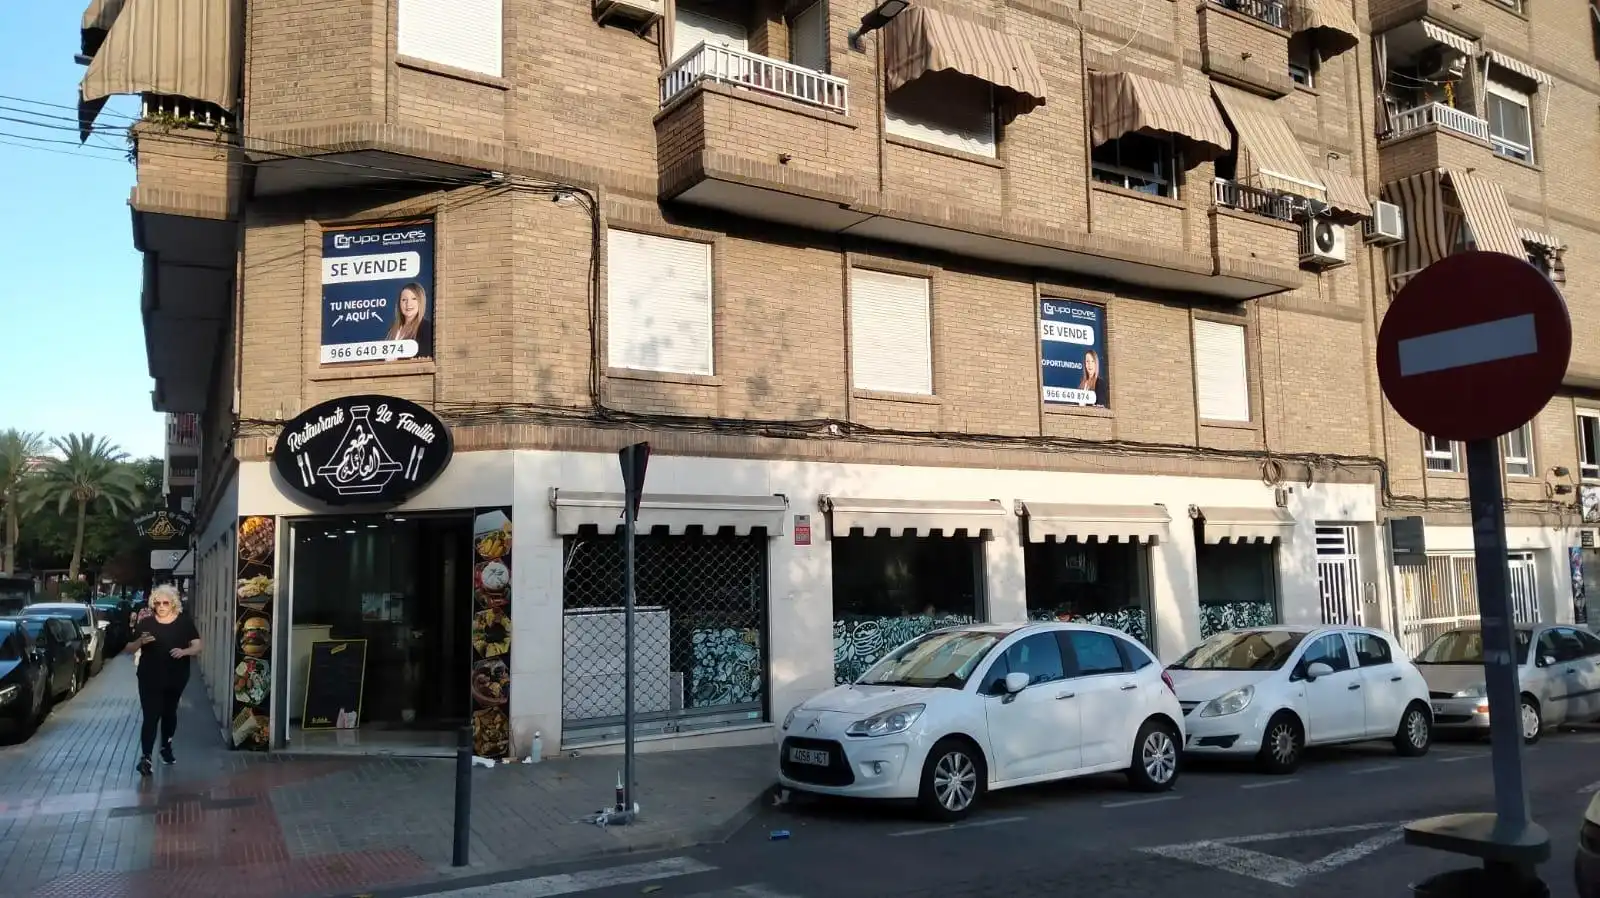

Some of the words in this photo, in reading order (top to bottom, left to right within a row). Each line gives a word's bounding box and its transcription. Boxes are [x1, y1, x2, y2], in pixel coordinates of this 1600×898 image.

[334, 233, 380, 249] Grupo
[330, 262, 348, 277] SE
[353, 258, 408, 275] VENDE
[329, 302, 342, 312] TU
[344, 298, 387, 310] NEGOCIO
[345, 309, 370, 322] AQUÍ
[1043, 324, 1055, 336] SE
[1056, 325, 1088, 340] VENDE
[330, 347, 352, 359] 966
[355, 345, 377, 357] 640
[382, 344, 405, 355] 874
[1041, 358, 1083, 370] OPORTUNIDAD
[1046, 390, 1060, 399] 966
[1061, 391, 1075, 400] 640
[1076, 392, 1090, 401] 874
[287, 405, 345, 452] Restaurante
[376, 403, 393, 424] La
[395, 412, 436, 444] Familia
